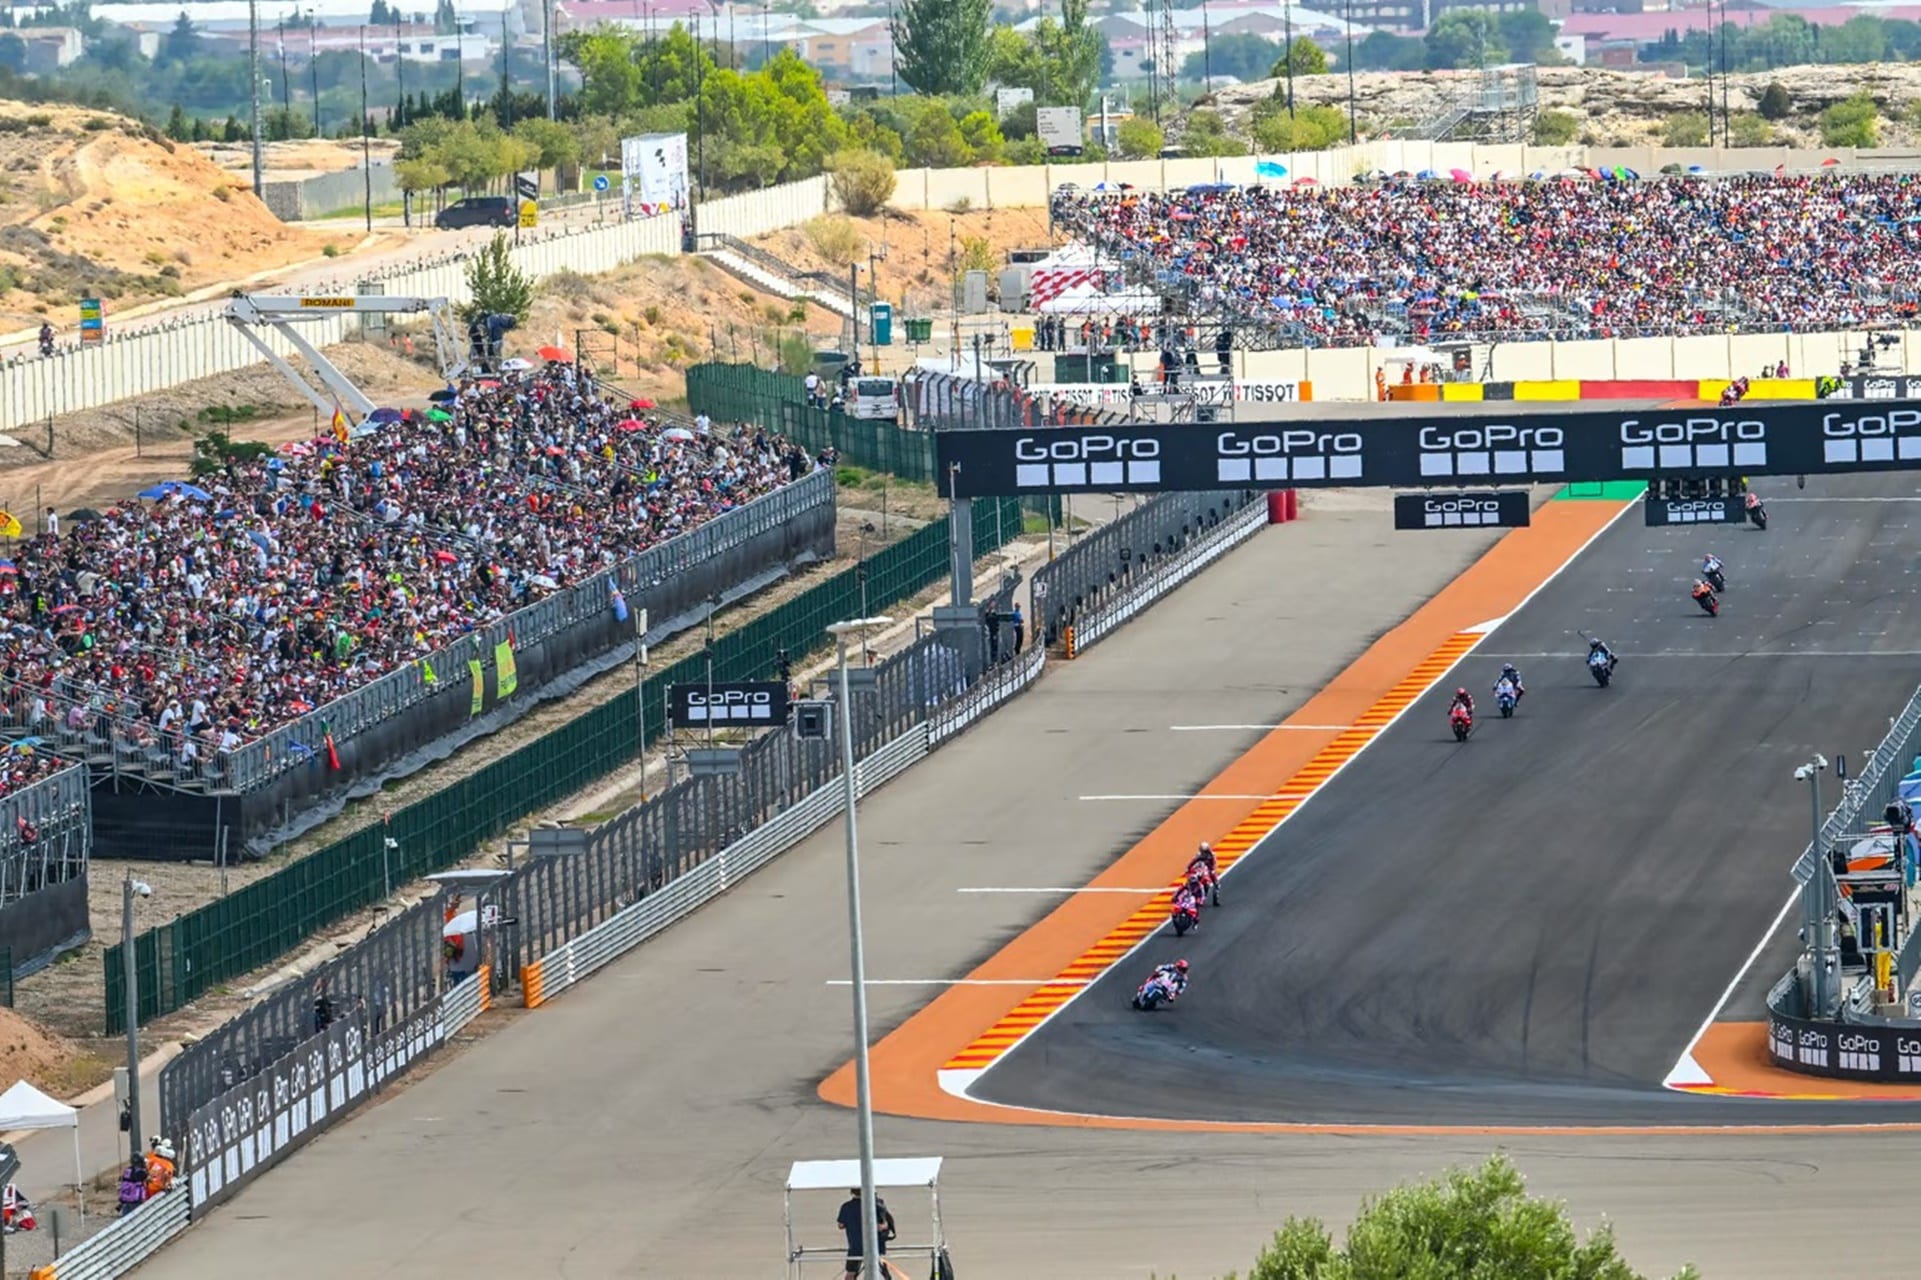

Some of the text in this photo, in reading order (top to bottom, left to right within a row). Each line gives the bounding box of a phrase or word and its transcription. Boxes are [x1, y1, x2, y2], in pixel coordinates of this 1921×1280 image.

[1242, 384, 1295, 401] TISSOT
[1016, 410, 1921, 461] GoPro GoPro GoPro GoPro GoP
[1424, 499, 1499, 512] GoPro
[1667, 501, 1725, 512] GoPro
[687, 690, 770, 705] GoPro
[1798, 1029, 1828, 1048] GoPro
[1838, 1033, 1880, 1053] GoPro
